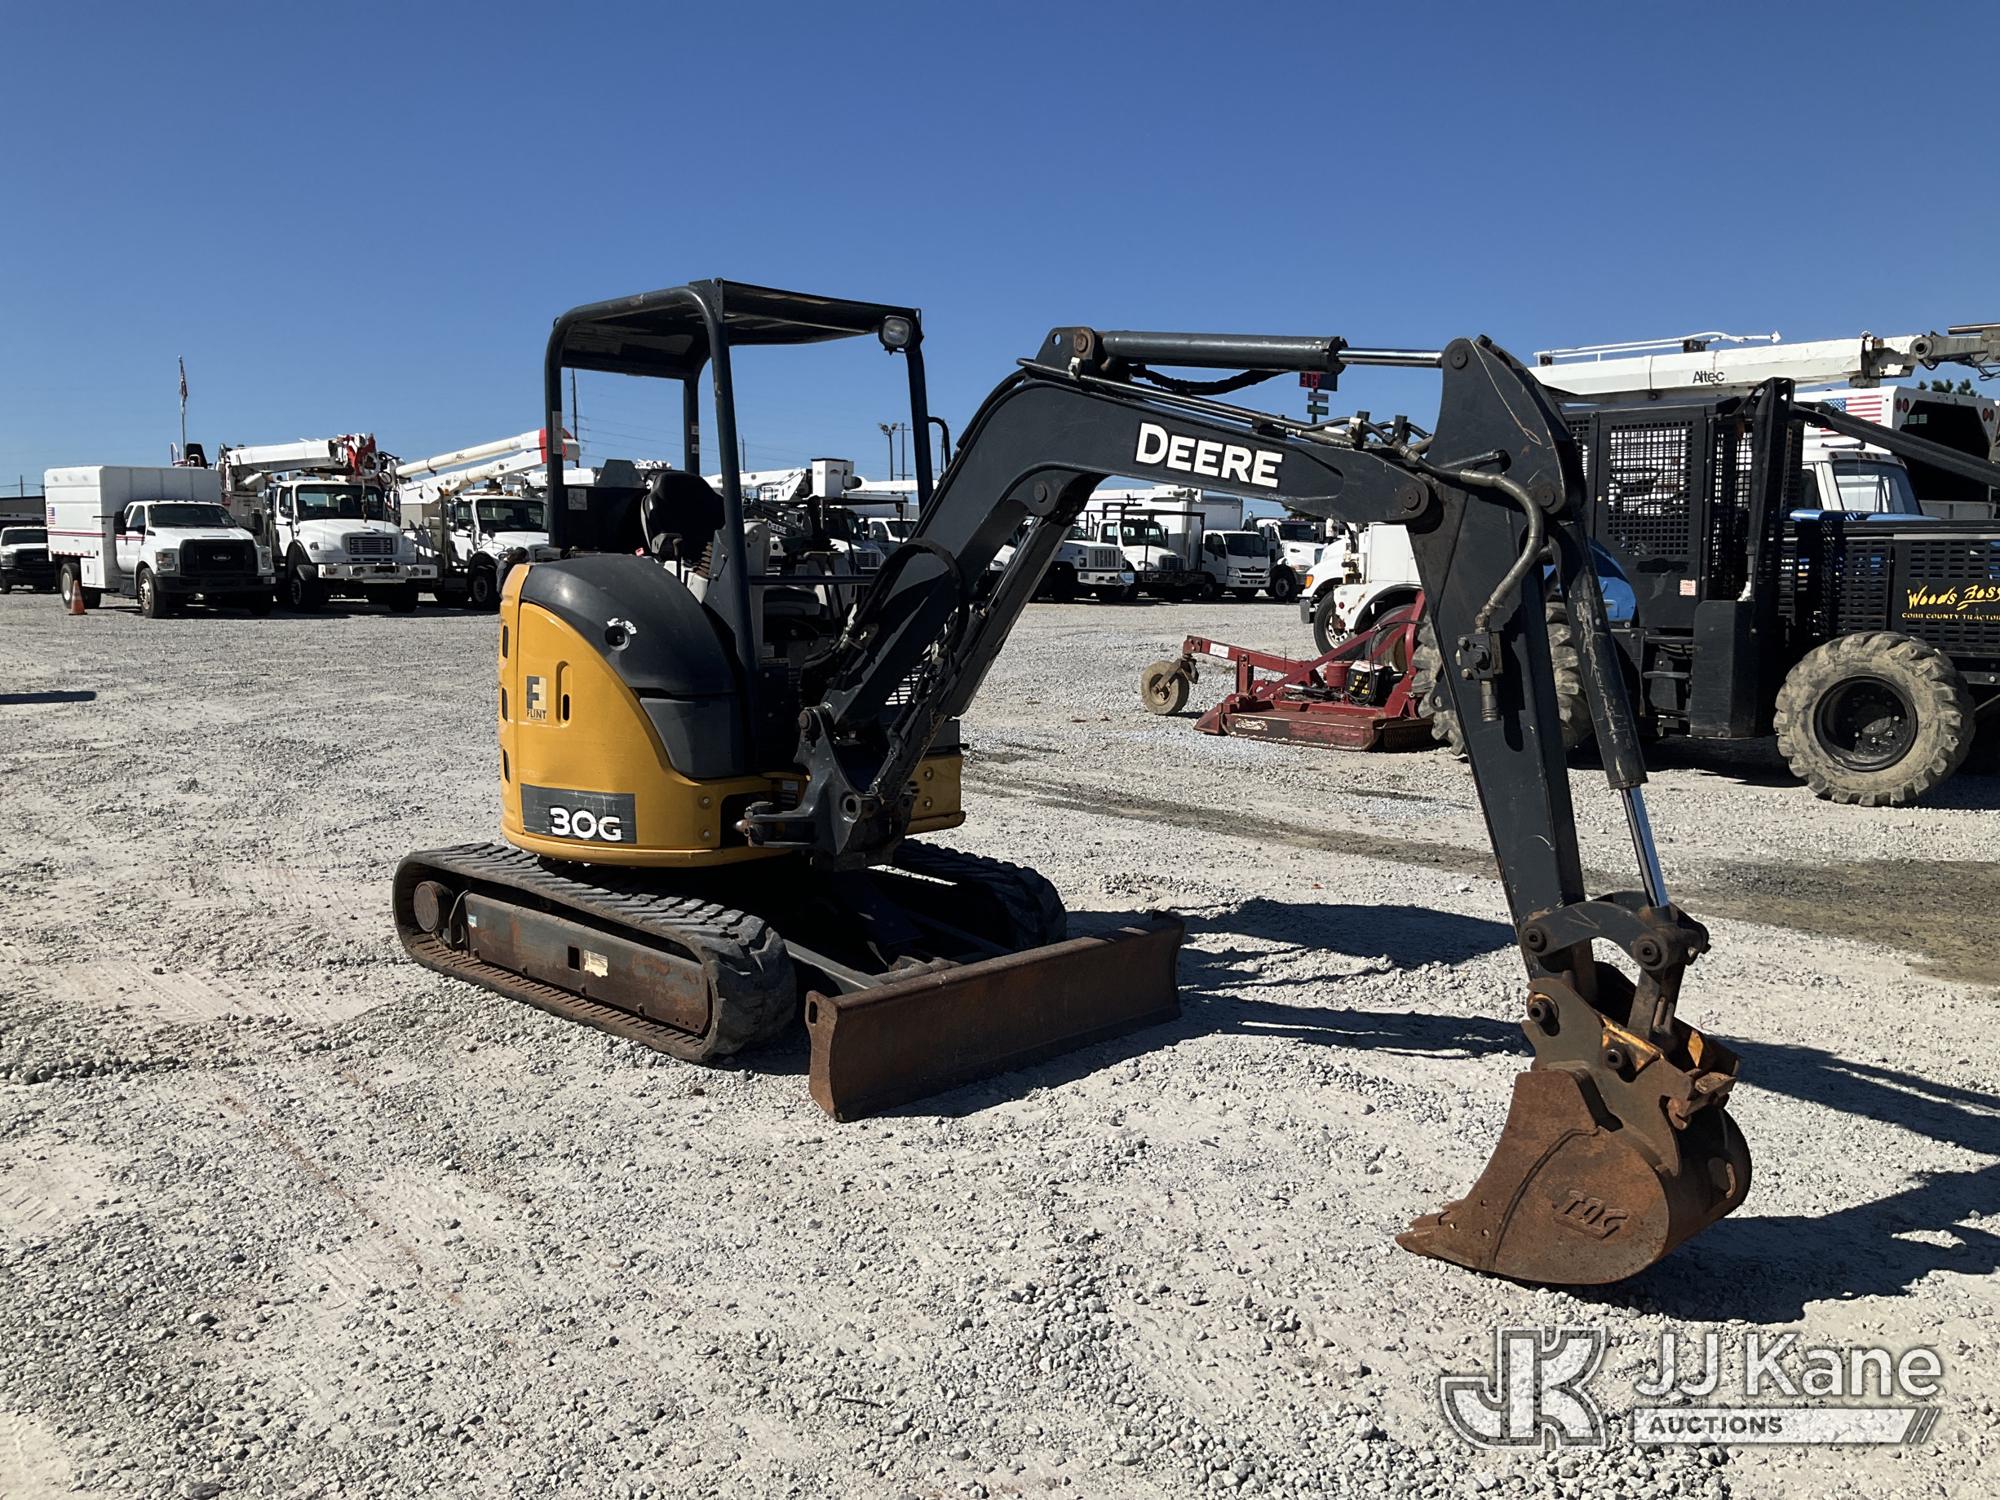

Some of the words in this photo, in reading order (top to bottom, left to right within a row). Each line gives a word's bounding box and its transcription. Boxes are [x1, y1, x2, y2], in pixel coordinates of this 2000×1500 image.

[1692, 370, 1725, 384] Altec
[1135, 422, 1283, 488] DEERE
[1906, 585, 1958, 609] Woods
[526, 708, 547, 720] FLINT
[549, 806, 622, 842] 30G
